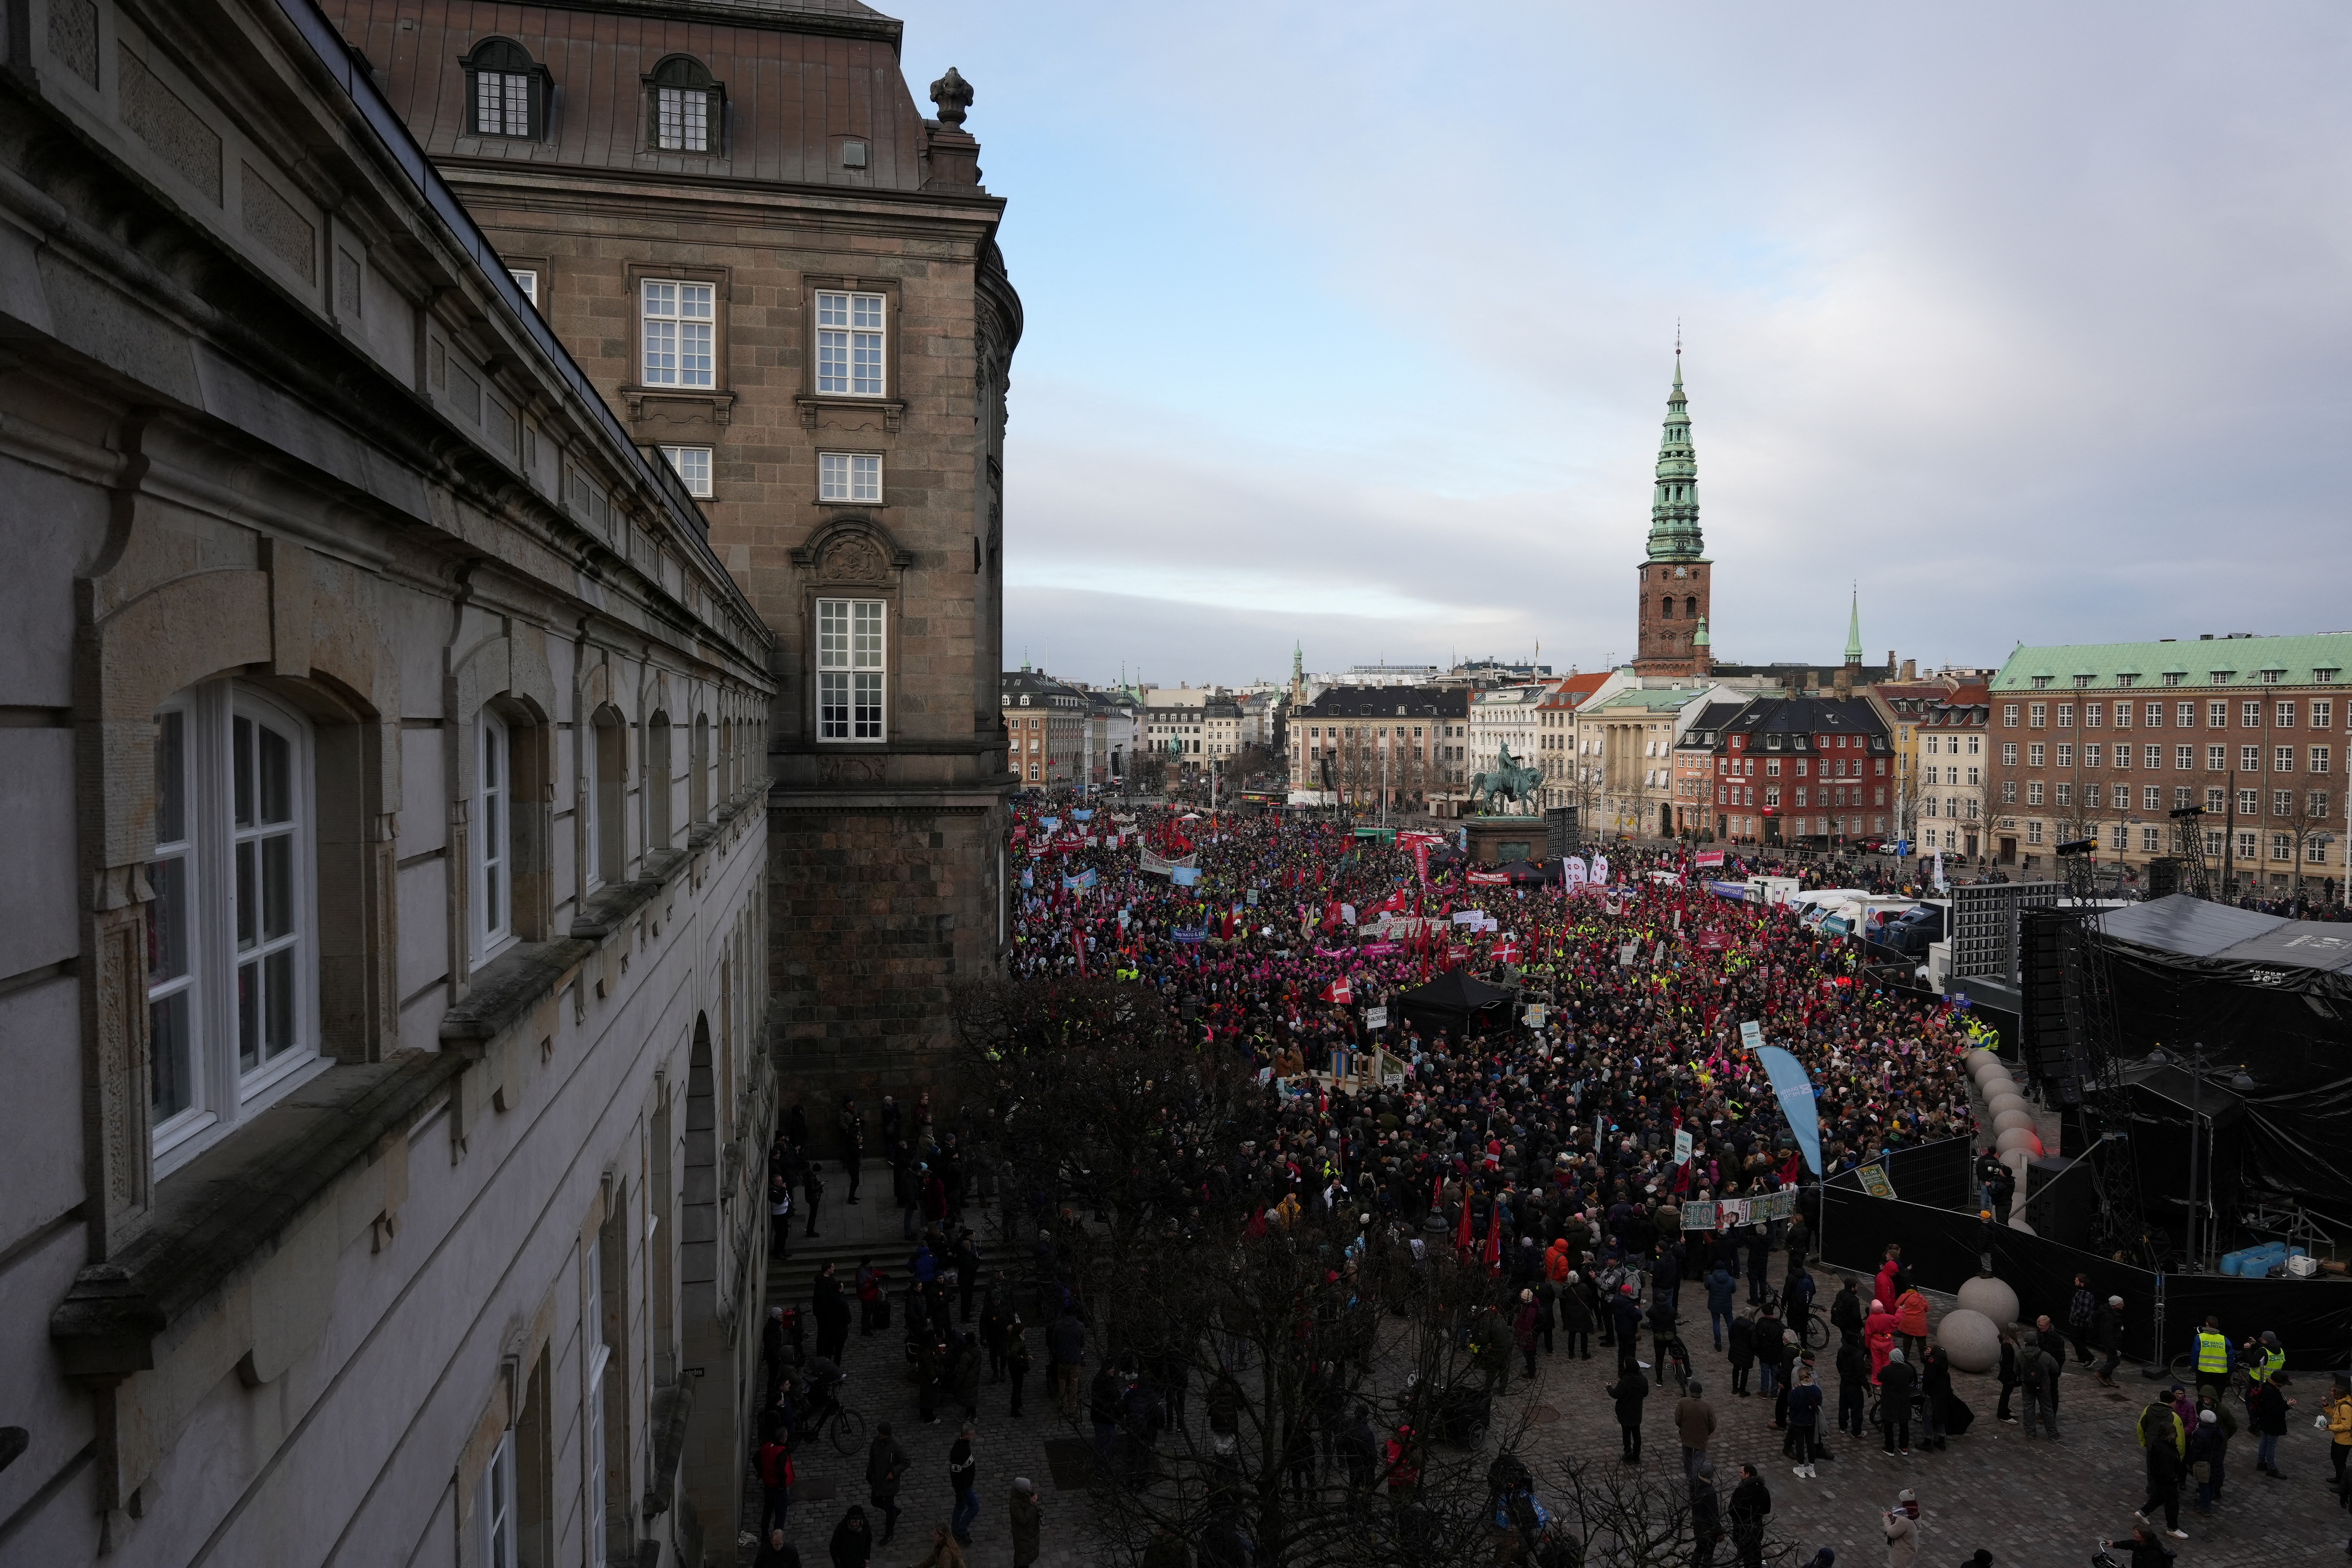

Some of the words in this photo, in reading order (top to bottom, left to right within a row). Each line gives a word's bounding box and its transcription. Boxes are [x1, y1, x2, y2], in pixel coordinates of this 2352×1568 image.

[1145, 851, 1178, 865] FINGRENE
[1179, 856, 1193, 864] VÆK
[1712, 885, 1742, 895] HANDICAPTOILET
[1366, 923, 1388, 934] BEDEDAG
[1827, 920, 1846, 933] Backstage
[1678, 1135, 1689, 1143] BEVAR
[1676, 1146, 1689, 1155] HELLIGDAG
